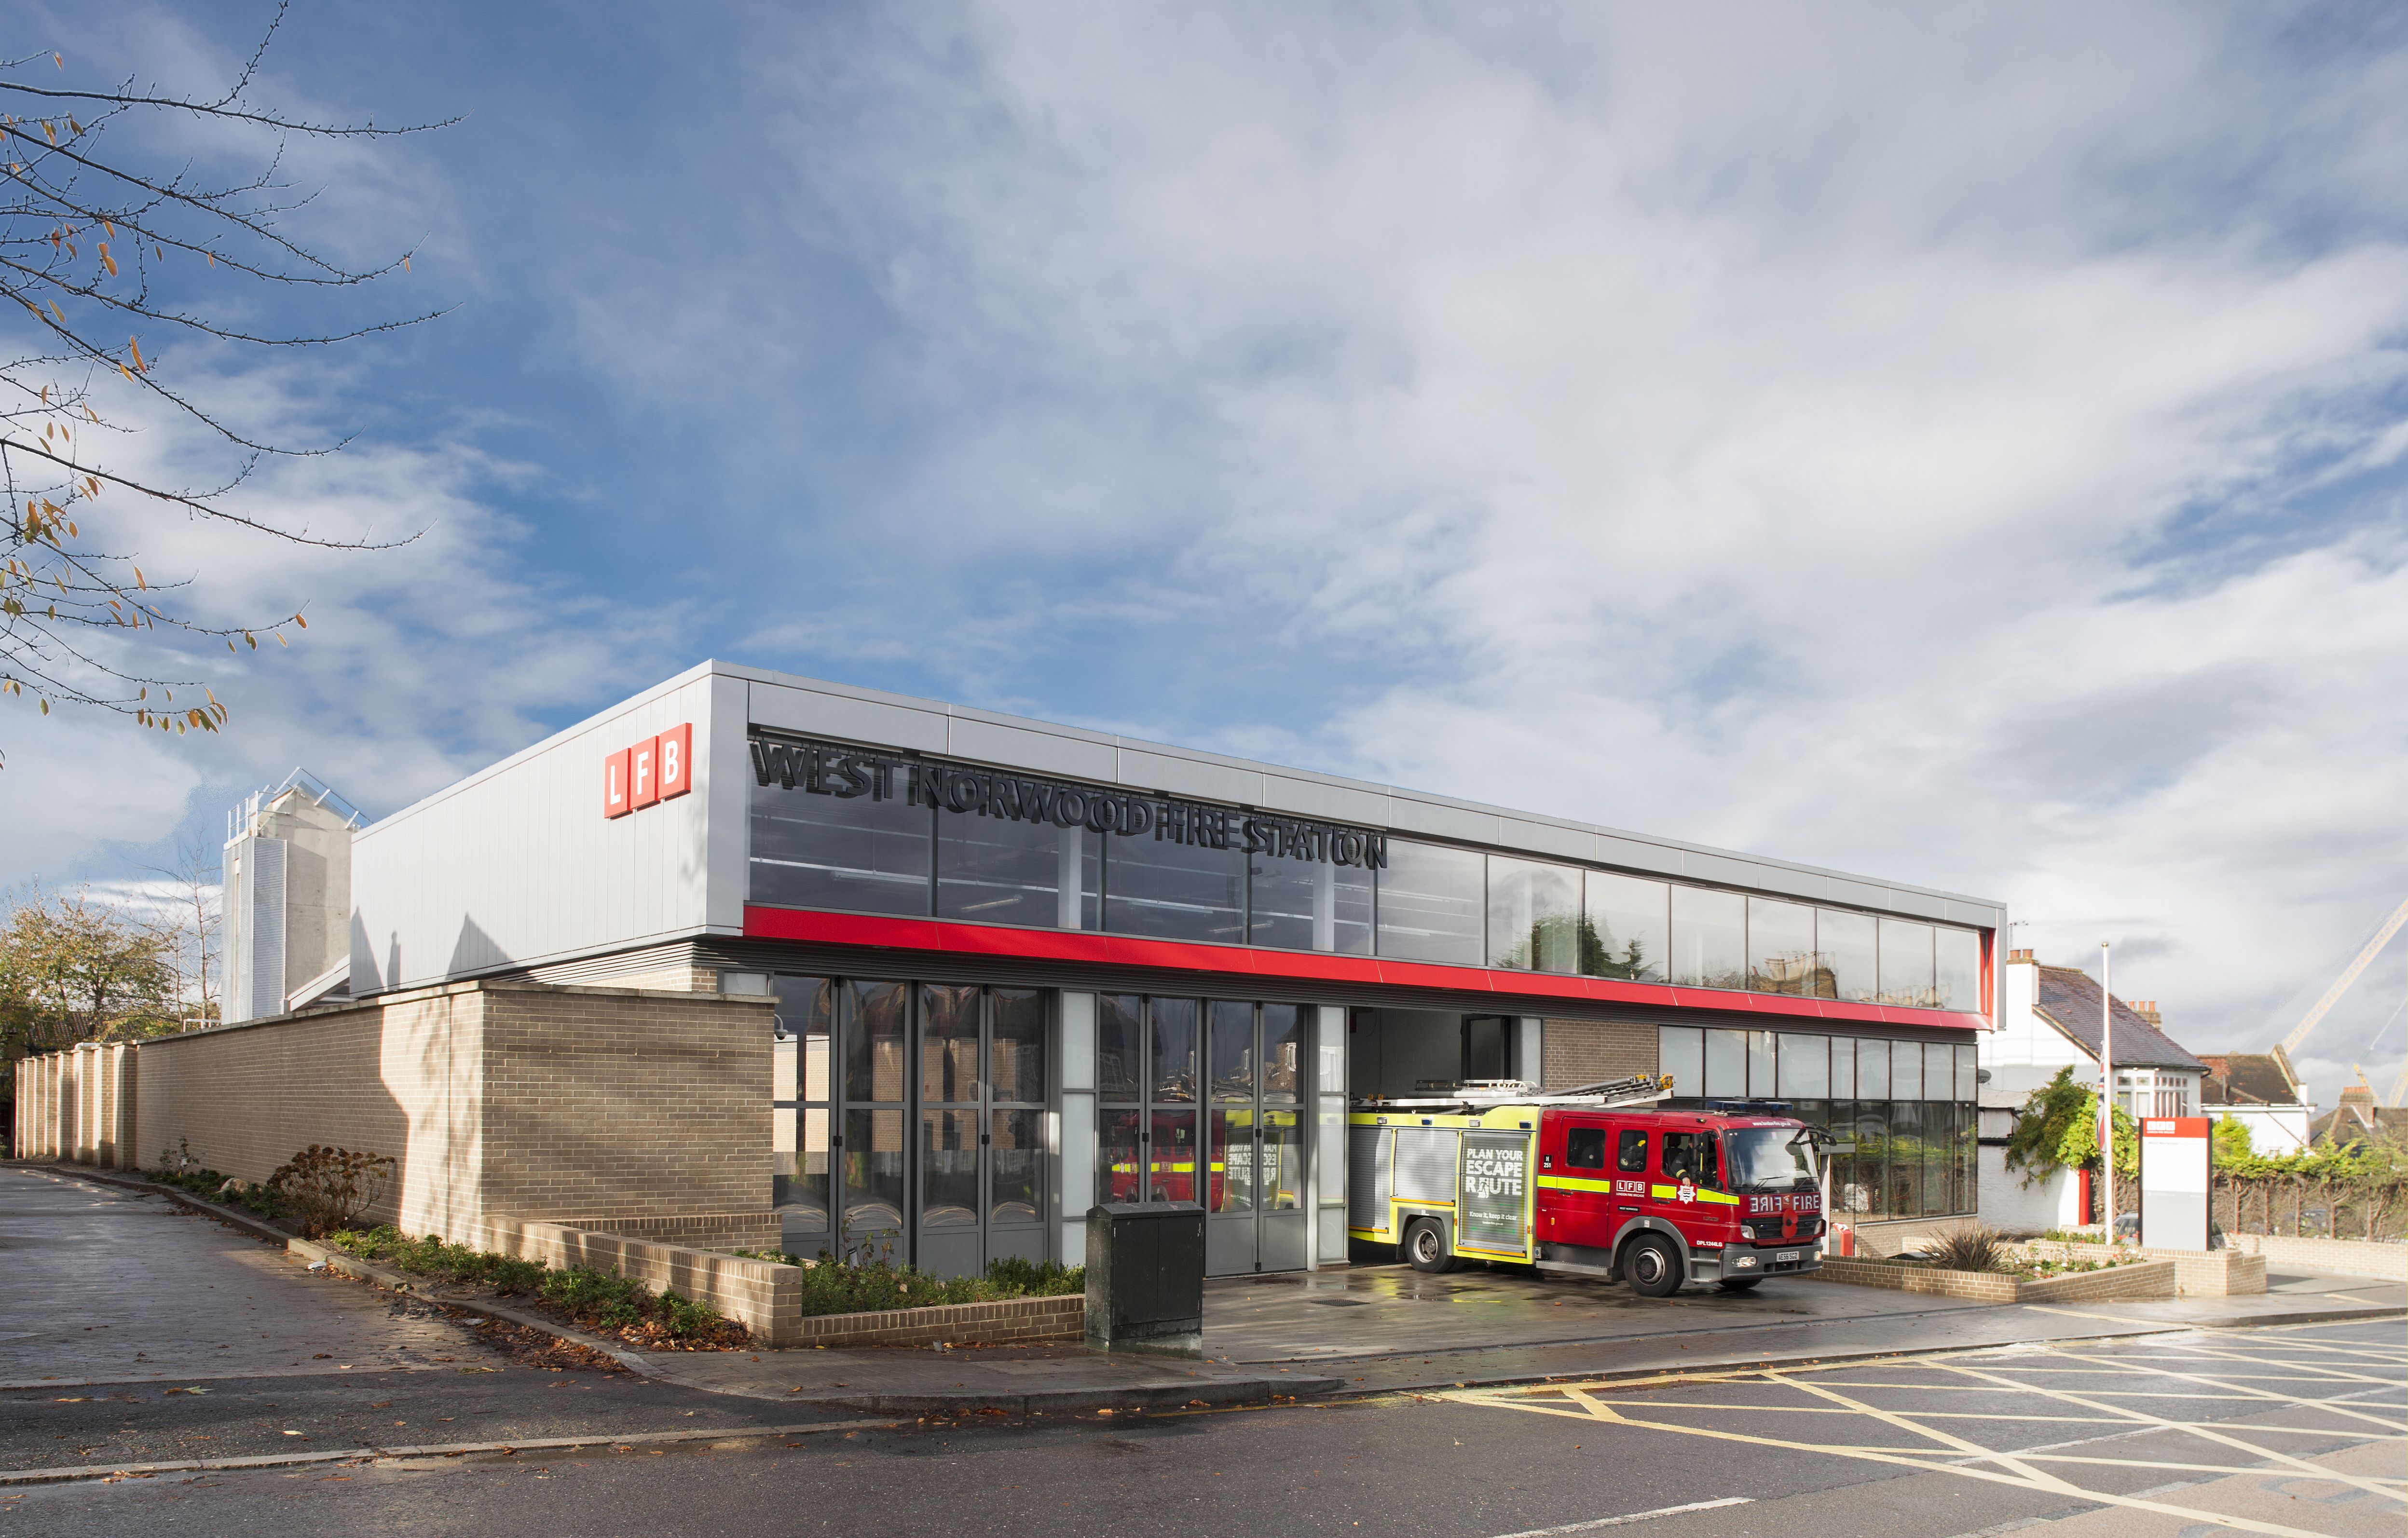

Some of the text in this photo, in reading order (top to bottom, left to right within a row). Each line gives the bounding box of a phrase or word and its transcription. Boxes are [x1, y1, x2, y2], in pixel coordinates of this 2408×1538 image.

[610, 740, 678, 804] LFB
[759, 740, 1388, 869] WEST NORWOOD FIRE STATION
[1467, 1148, 1523, 1160] PLAN YOUR
[1465, 1160, 1522, 1177] ESCAPE
[1618, 1182, 1643, 1191] LFB
[1792, 1195, 1820, 1211] FIRE
